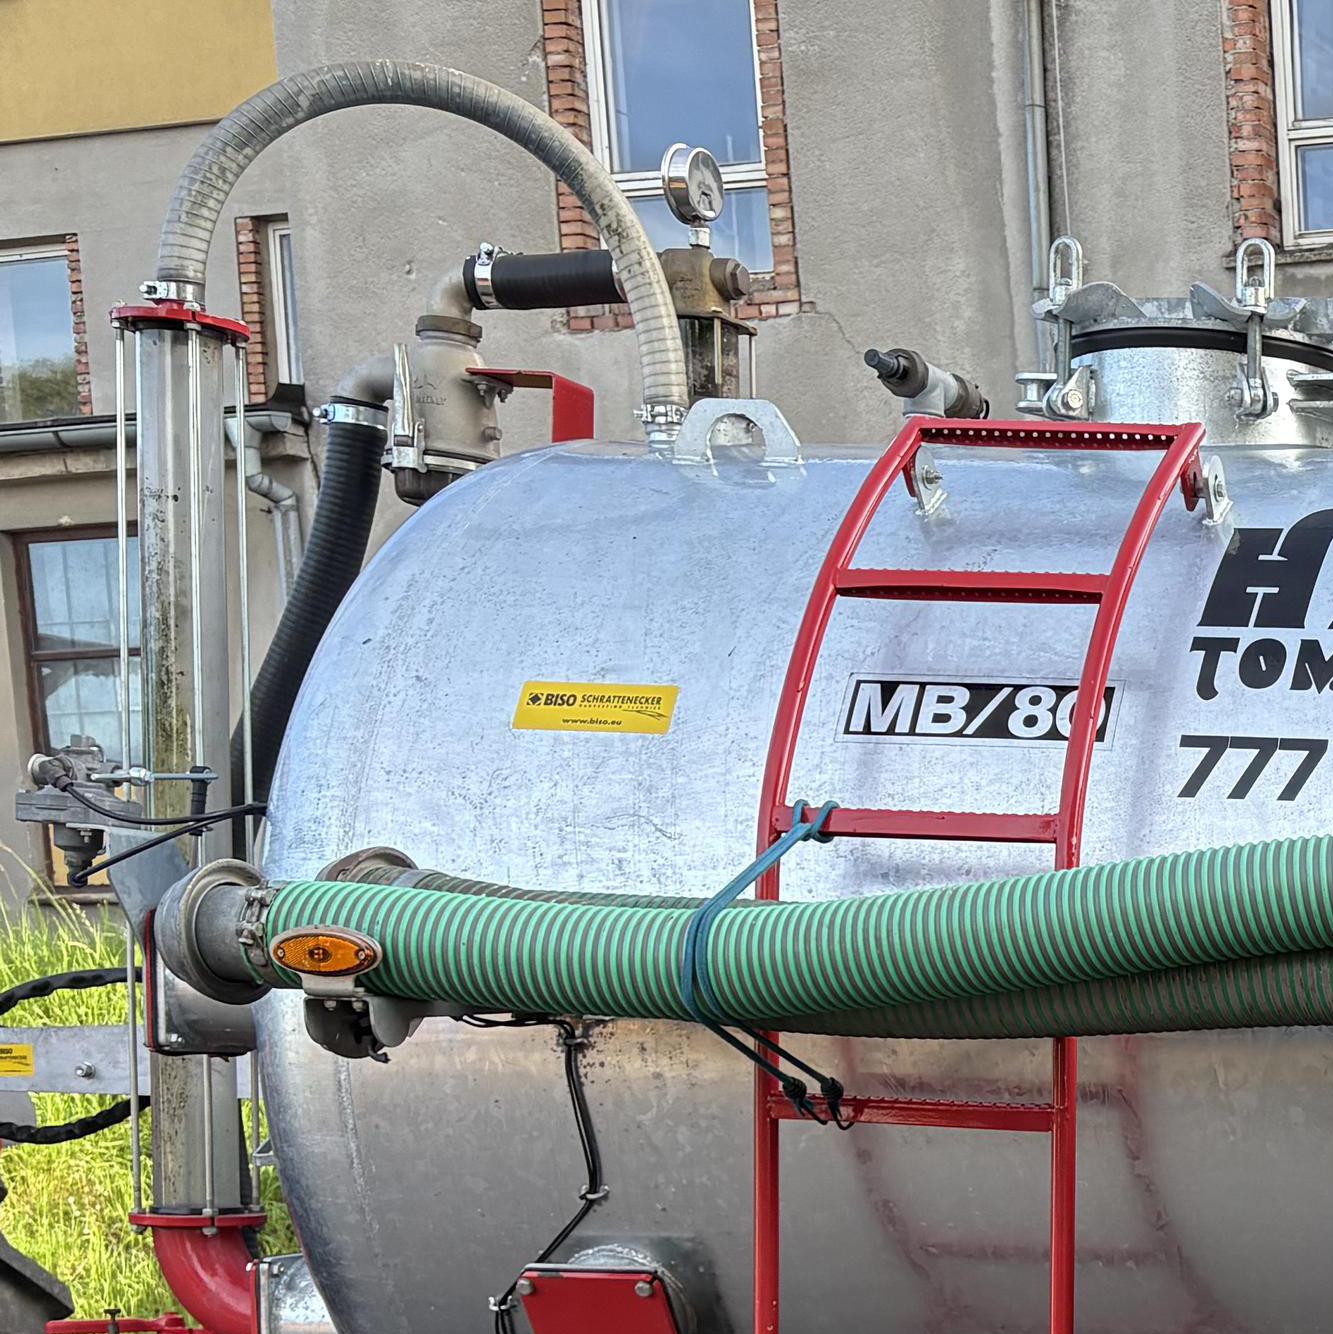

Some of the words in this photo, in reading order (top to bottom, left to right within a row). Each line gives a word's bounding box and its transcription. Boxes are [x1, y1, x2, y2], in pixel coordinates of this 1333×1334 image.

[543, 693, 577, 707] BISO
[580, 694, 663, 705] SCHRATTENECKER
[562, 717, 622, 726] www.biso.eu
[1178, 734, 1328, 800] 777
